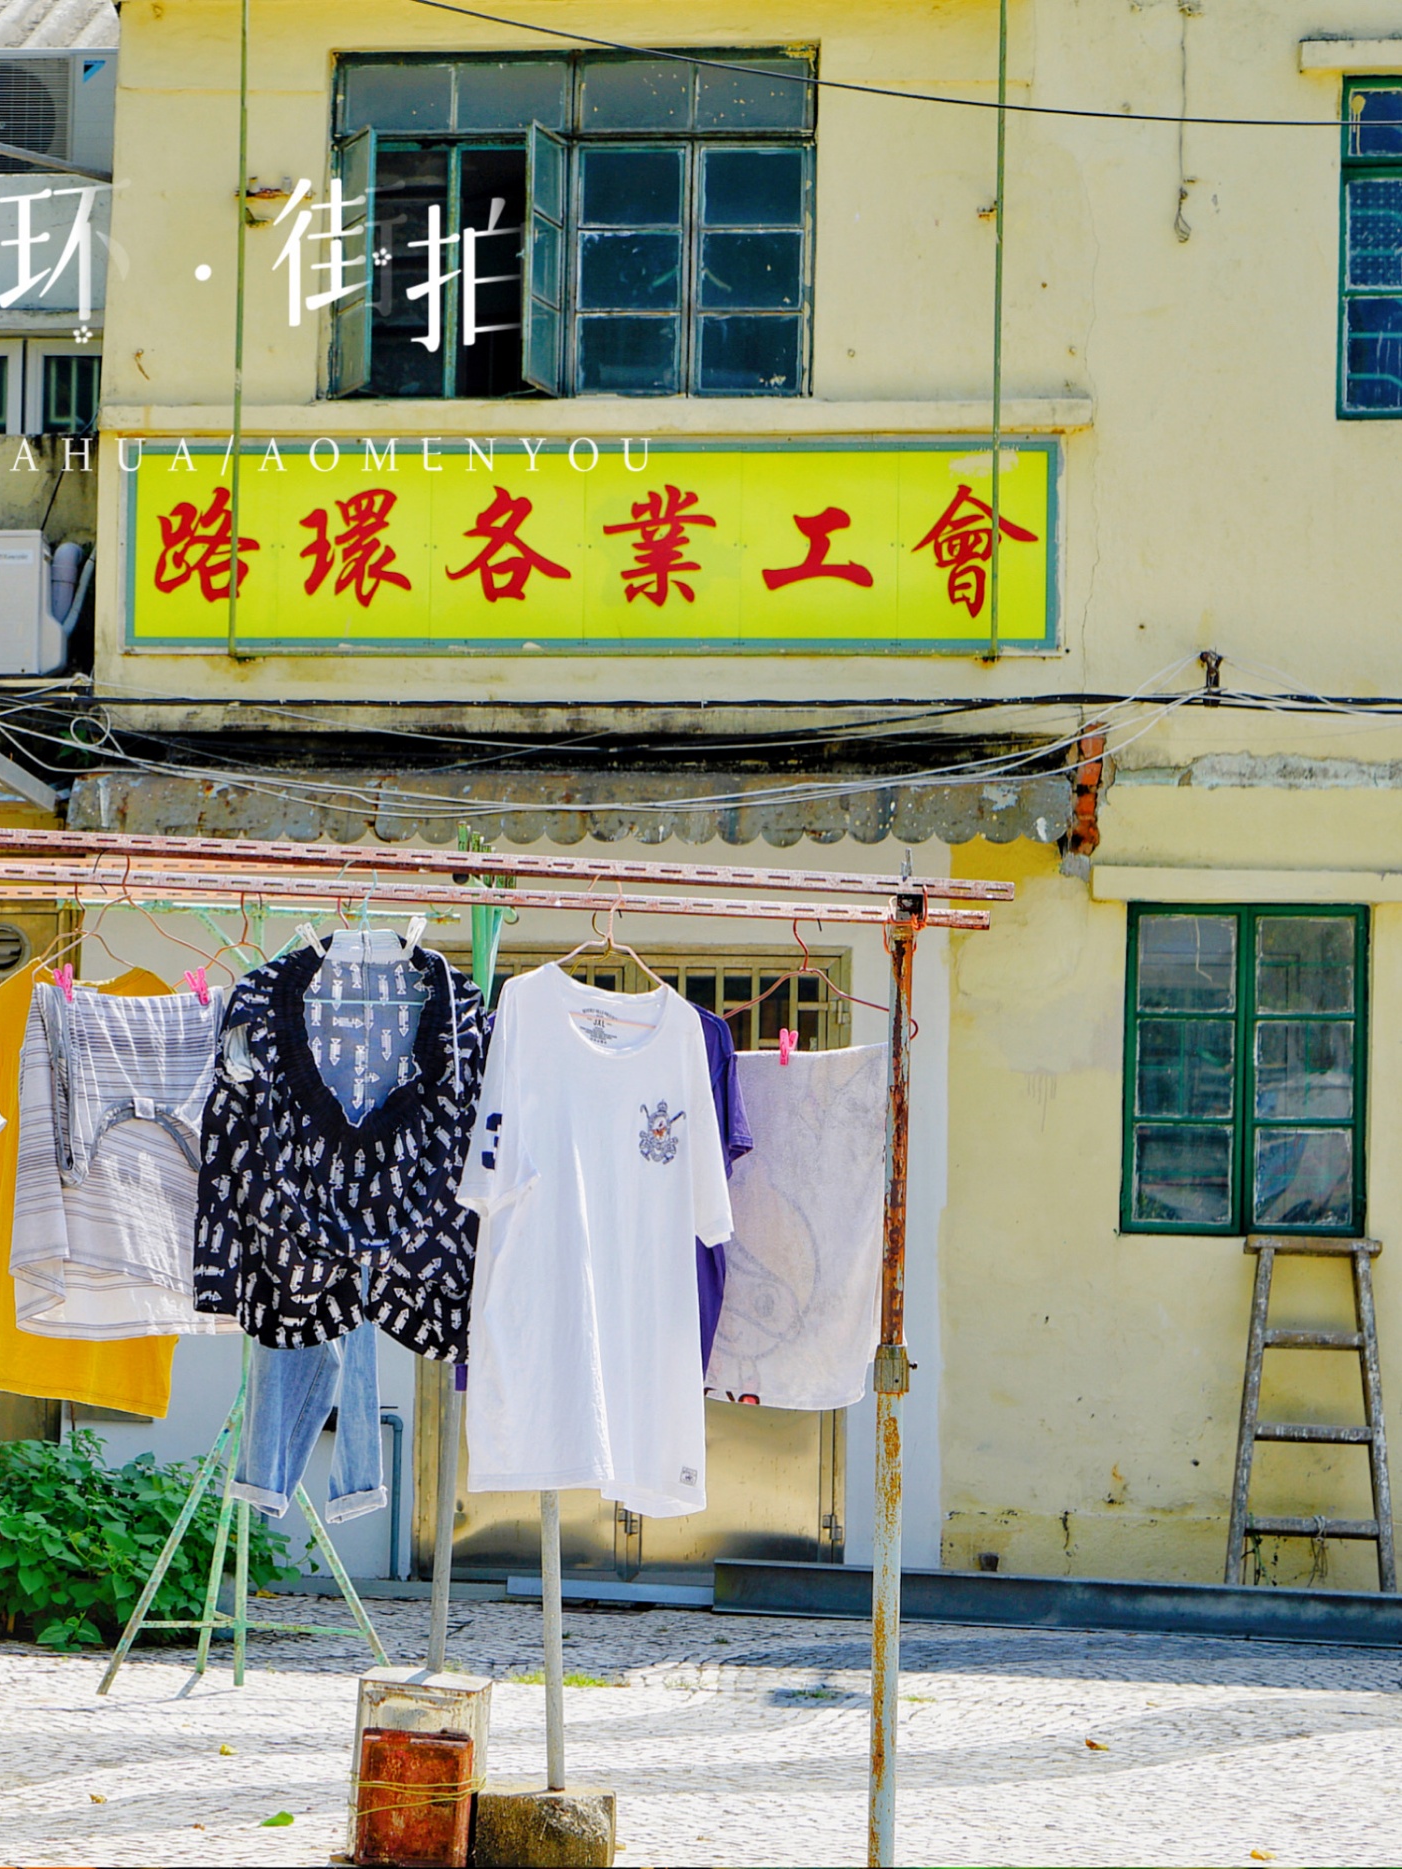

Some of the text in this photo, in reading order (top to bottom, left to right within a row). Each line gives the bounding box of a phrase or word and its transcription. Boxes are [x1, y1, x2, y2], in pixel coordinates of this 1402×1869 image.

[154, 484, 1039, 618] 路環各業工會
